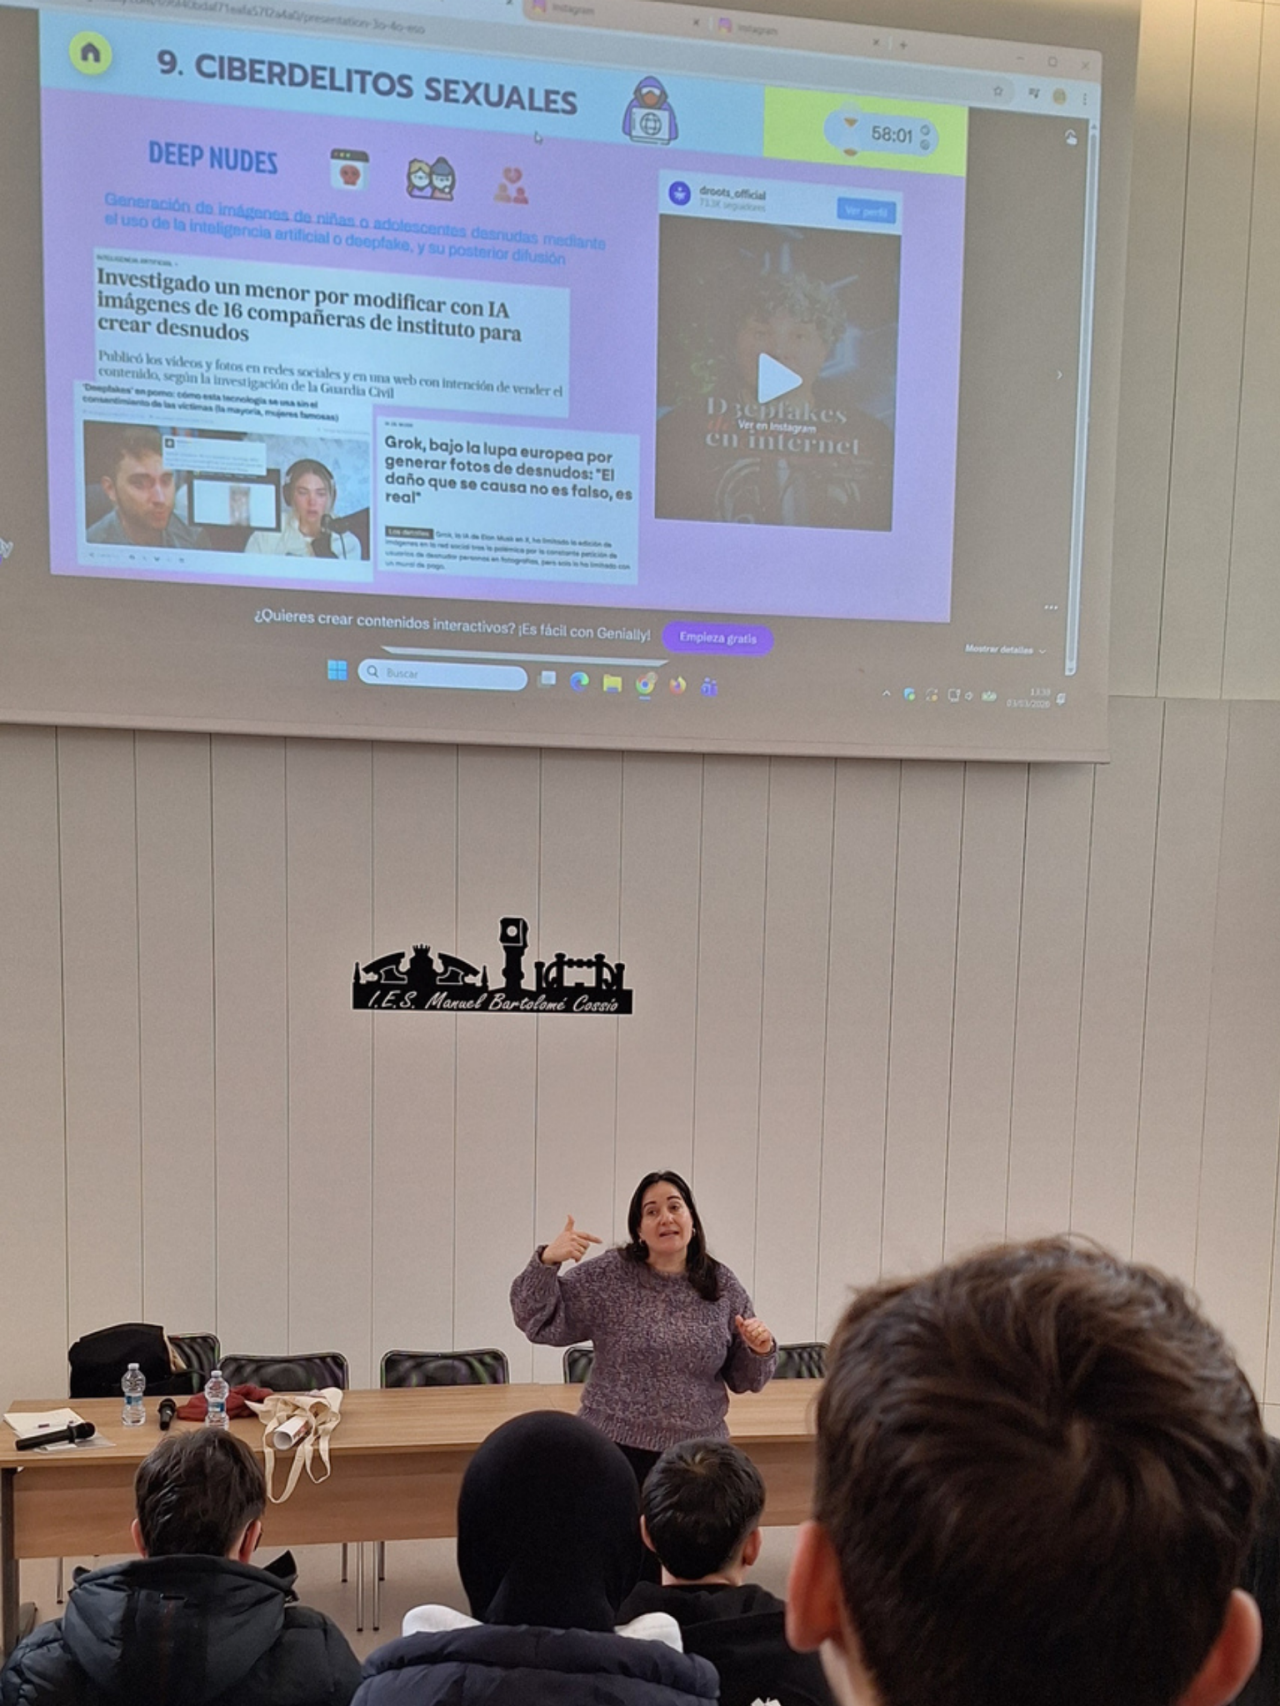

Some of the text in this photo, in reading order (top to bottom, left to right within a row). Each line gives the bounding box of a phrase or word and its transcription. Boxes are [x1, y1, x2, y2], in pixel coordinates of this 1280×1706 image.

[552, 4, 595, 16] Instagram
[738, 23, 778, 36] Instagram
[157, 49, 578, 116] 9. CIBERDELITOS SEXUALES
[872, 126, 913, 144] 58:01
[149, 140, 278, 174] DEEP NUDES
[699, 186, 766, 201] droots_official
[105, 192, 606, 250] Generación de imágenes de niñas o adolescentes desnudas mediante
[845, 205, 888, 220] Ver perfil
[105, 213, 566, 266] el uso de la inteligencia artificial o deepfake, y su posterior difusión
[97, 267, 510, 318] Investigado un menor por modificar con IA
[97, 290, 522, 343] imágenes de 16 compañeras de instituto para
[98, 315, 250, 342] crear desnudos
[98, 350, 563, 397] Publicó los vídeos y fotos en redes sociales y en una web con intención de vender el
[98, 366, 394, 399] contenido, según la investigación de la Guardia Civil
[82, 395, 150, 408] consentimiento
[151, 399, 163, 409] de
[164, 400, 176, 410] las
[178, 401, 214, 412] víctimas
[215, 403, 226, 414] (la
[227, 405, 263, 417] mayoría,
[265, 408, 299, 420] mujeres
[300, 410, 339, 422] famosas)
[135, 386, 149, 395] en
[149, 388, 176, 399] porno:
[177, 389, 202, 400] cómo
[203, 392, 221, 401] esta
[222, 393, 266, 406] tecnología
[268, 398, 279, 406] se
[280, 399, 296, 407] usa
[297, 399, 309, 408] sin
[309, 400, 318, 409] el
[738, 419, 754, 430] Ver
[756, 422, 768, 431] en
[770, 421, 817, 435] Instagram
[385, 435, 613, 466] Grok, bajo la lupa europea por
[705, 430, 860, 455] en internet
[385, 456, 615, 481] generar fotos de desnudos: "El
[385, 472, 633, 501] daño que se causa no es falso, es
[385, 491, 421, 504] real"
[254, 608, 651, 644] ¿Quieres crear contenidos interactivos? ¡Es fácil con Genially!
[680, 631, 757, 646] Empieza gratis
[965, 643, 1033, 655] Mostrar detalles
[387, 667, 419, 679] Buscar
[367, 990, 619, 1012] I.E.S. Manuel Bartolomé Cossío
